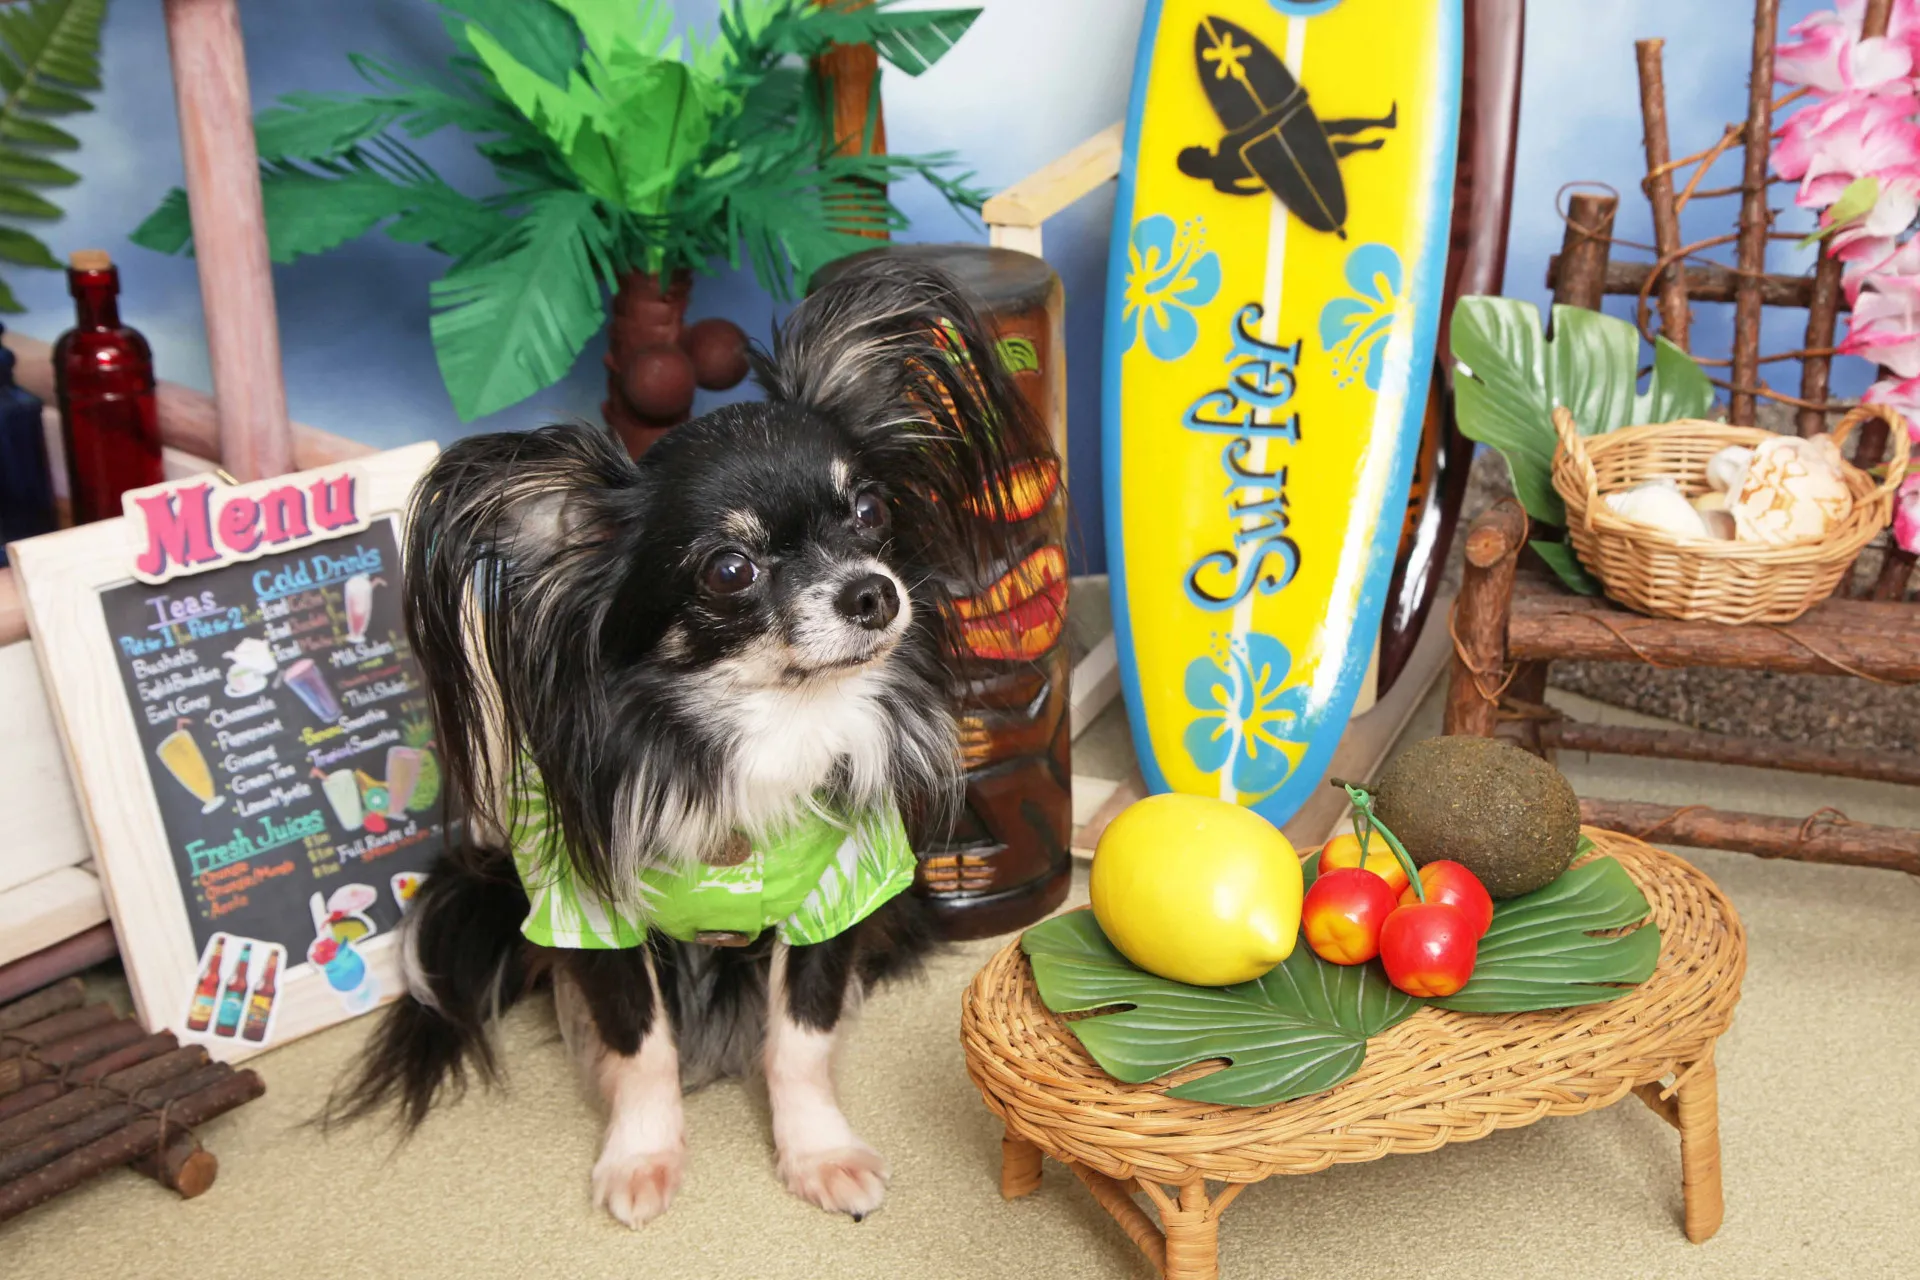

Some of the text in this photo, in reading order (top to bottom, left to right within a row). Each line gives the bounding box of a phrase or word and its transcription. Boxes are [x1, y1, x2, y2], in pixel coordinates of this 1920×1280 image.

[1180, 302, 1303, 613] Surfer
[134, 472, 360, 577] Menu
[254, 546, 381, 598] Cold Drinks
[146, 592, 217, 624] Teas
[186, 829, 257, 876] Fresh
[257, 810, 326, 847] Juices
